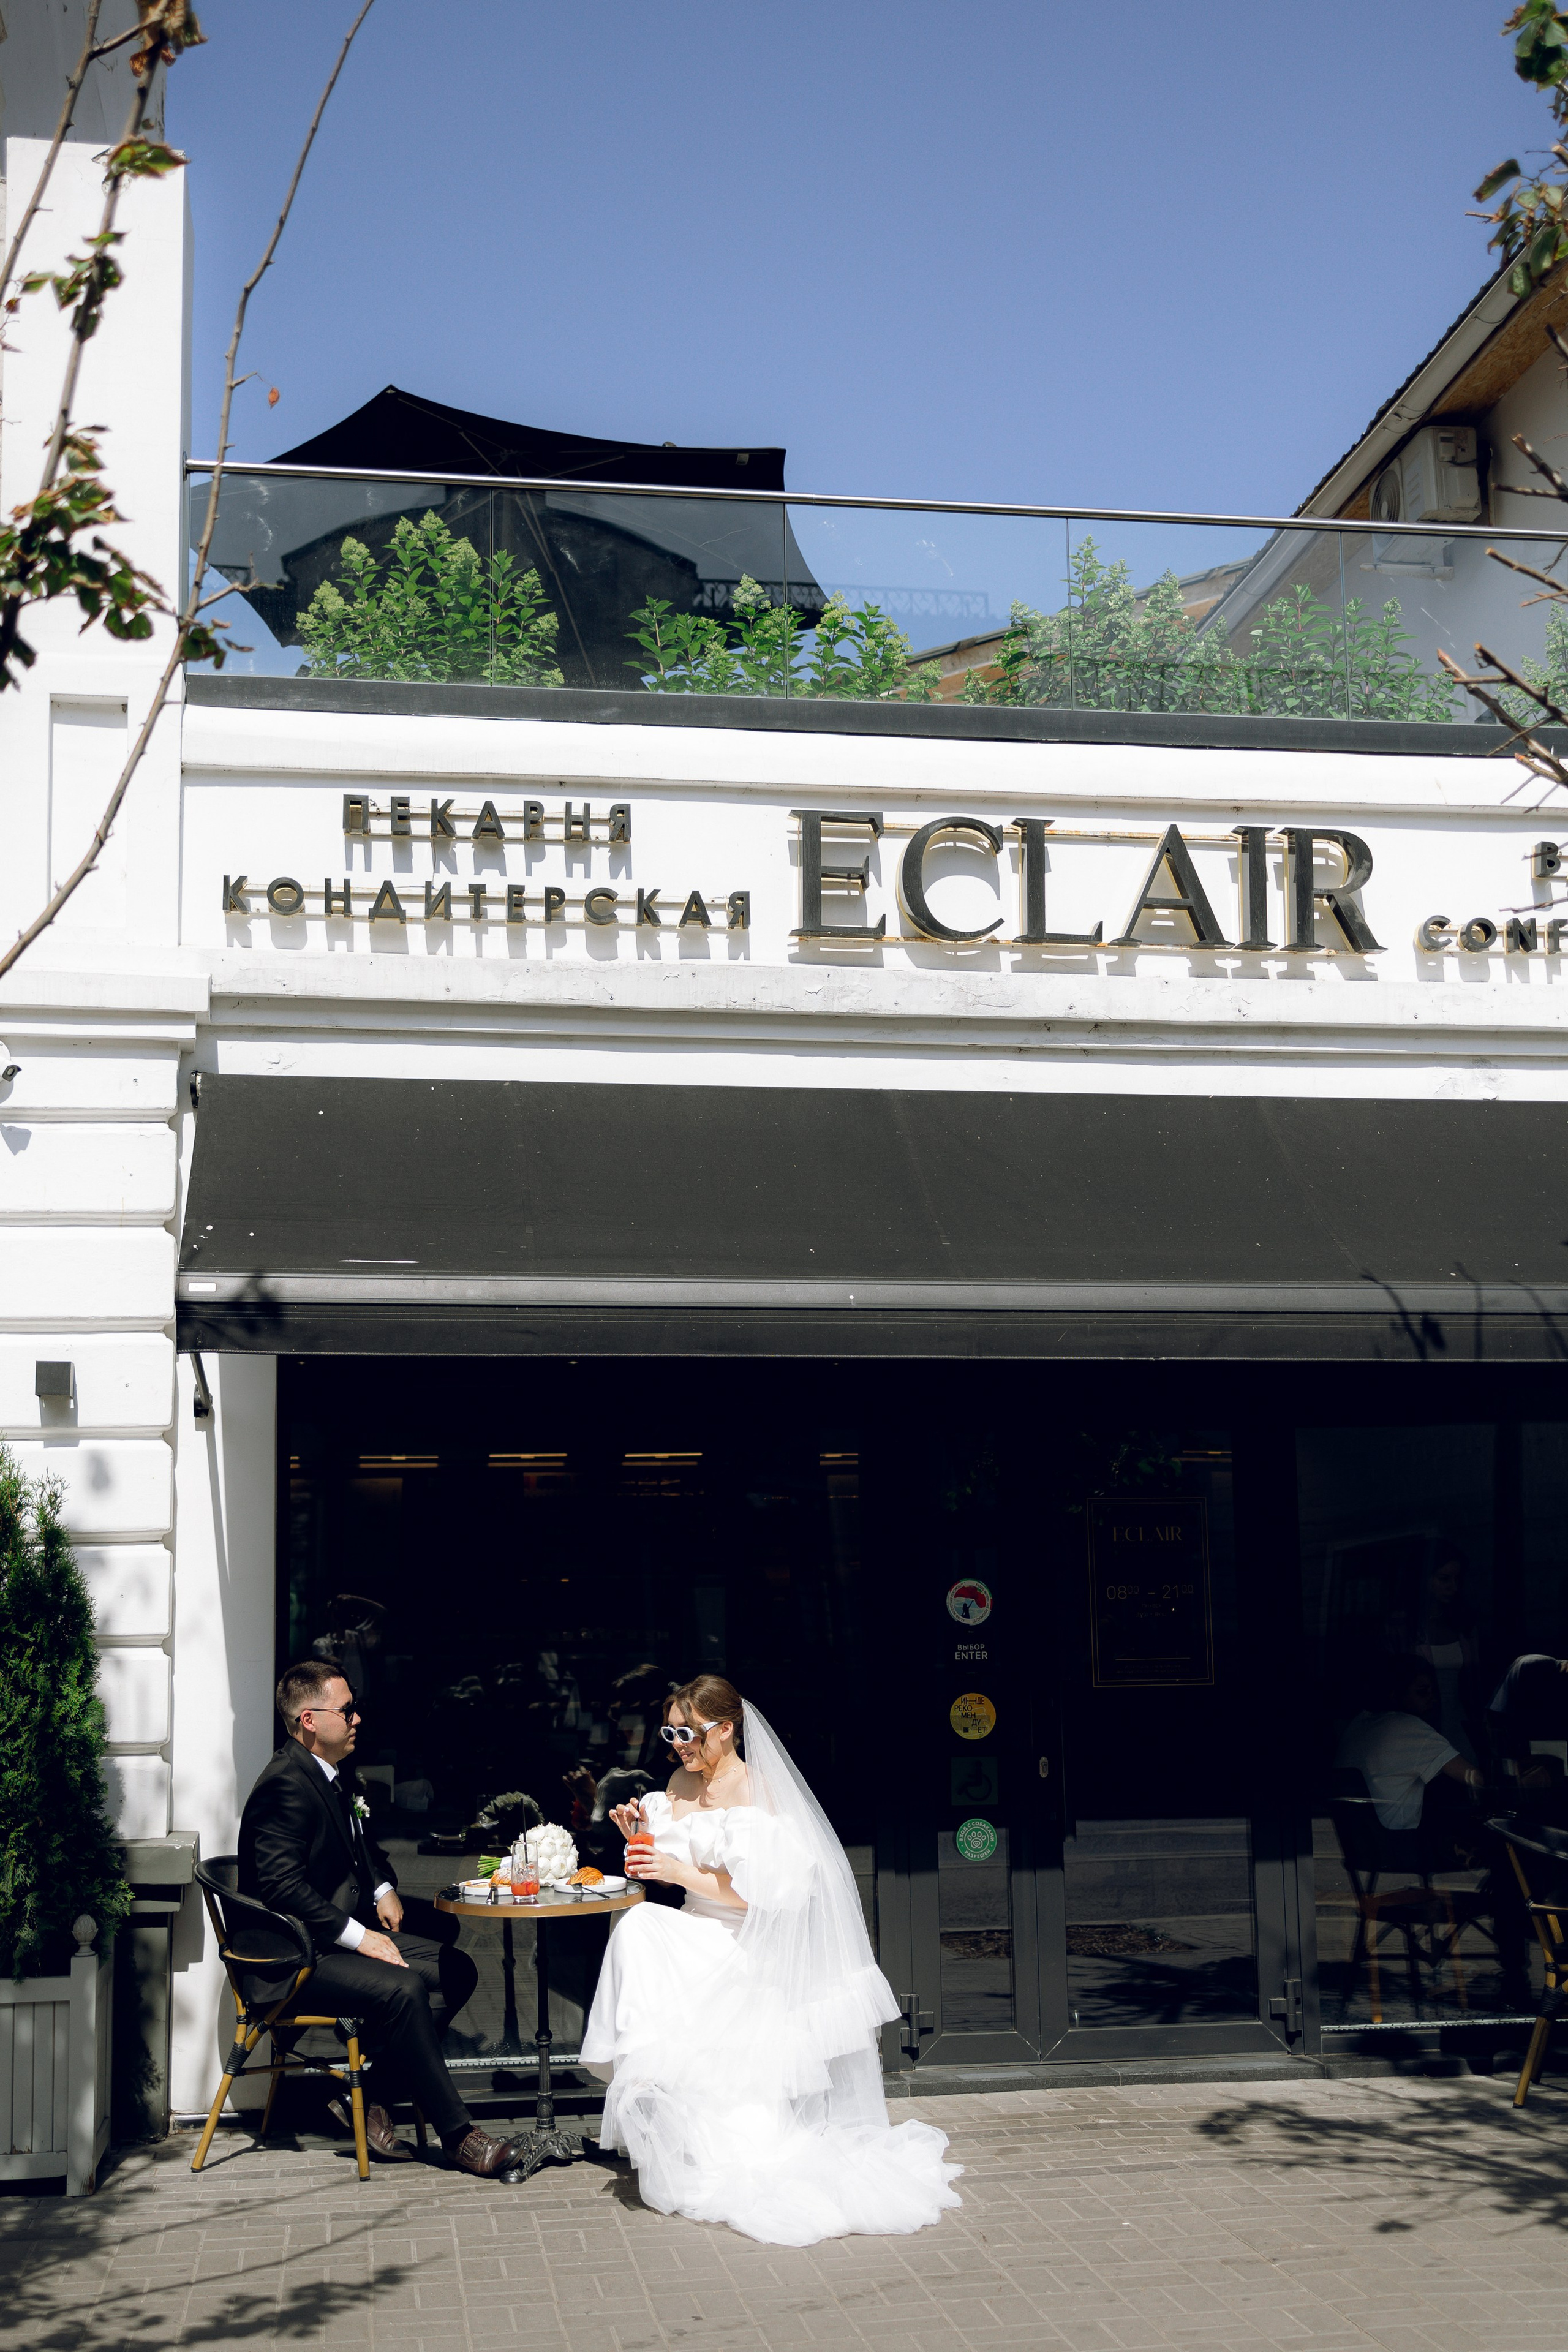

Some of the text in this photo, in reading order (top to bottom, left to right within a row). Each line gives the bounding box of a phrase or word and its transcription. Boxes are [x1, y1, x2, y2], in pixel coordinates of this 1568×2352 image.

[343, 794, 631, 842] ПЕКАРНЯ
[789, 809, 1388, 954] ECLAIR
[222, 875, 751, 929] КОНДИТЕРСКАЯ
[1112, 1526, 1182, 1542] ECLAIR
[955, 1651, 988, 1660] ENTER
[959, 1826, 968, 1841] ВХОД
[972, 1821, 995, 1842] СОБАКАМИ
[964, 1849, 991, 1858] РАЗРЕШЕН
